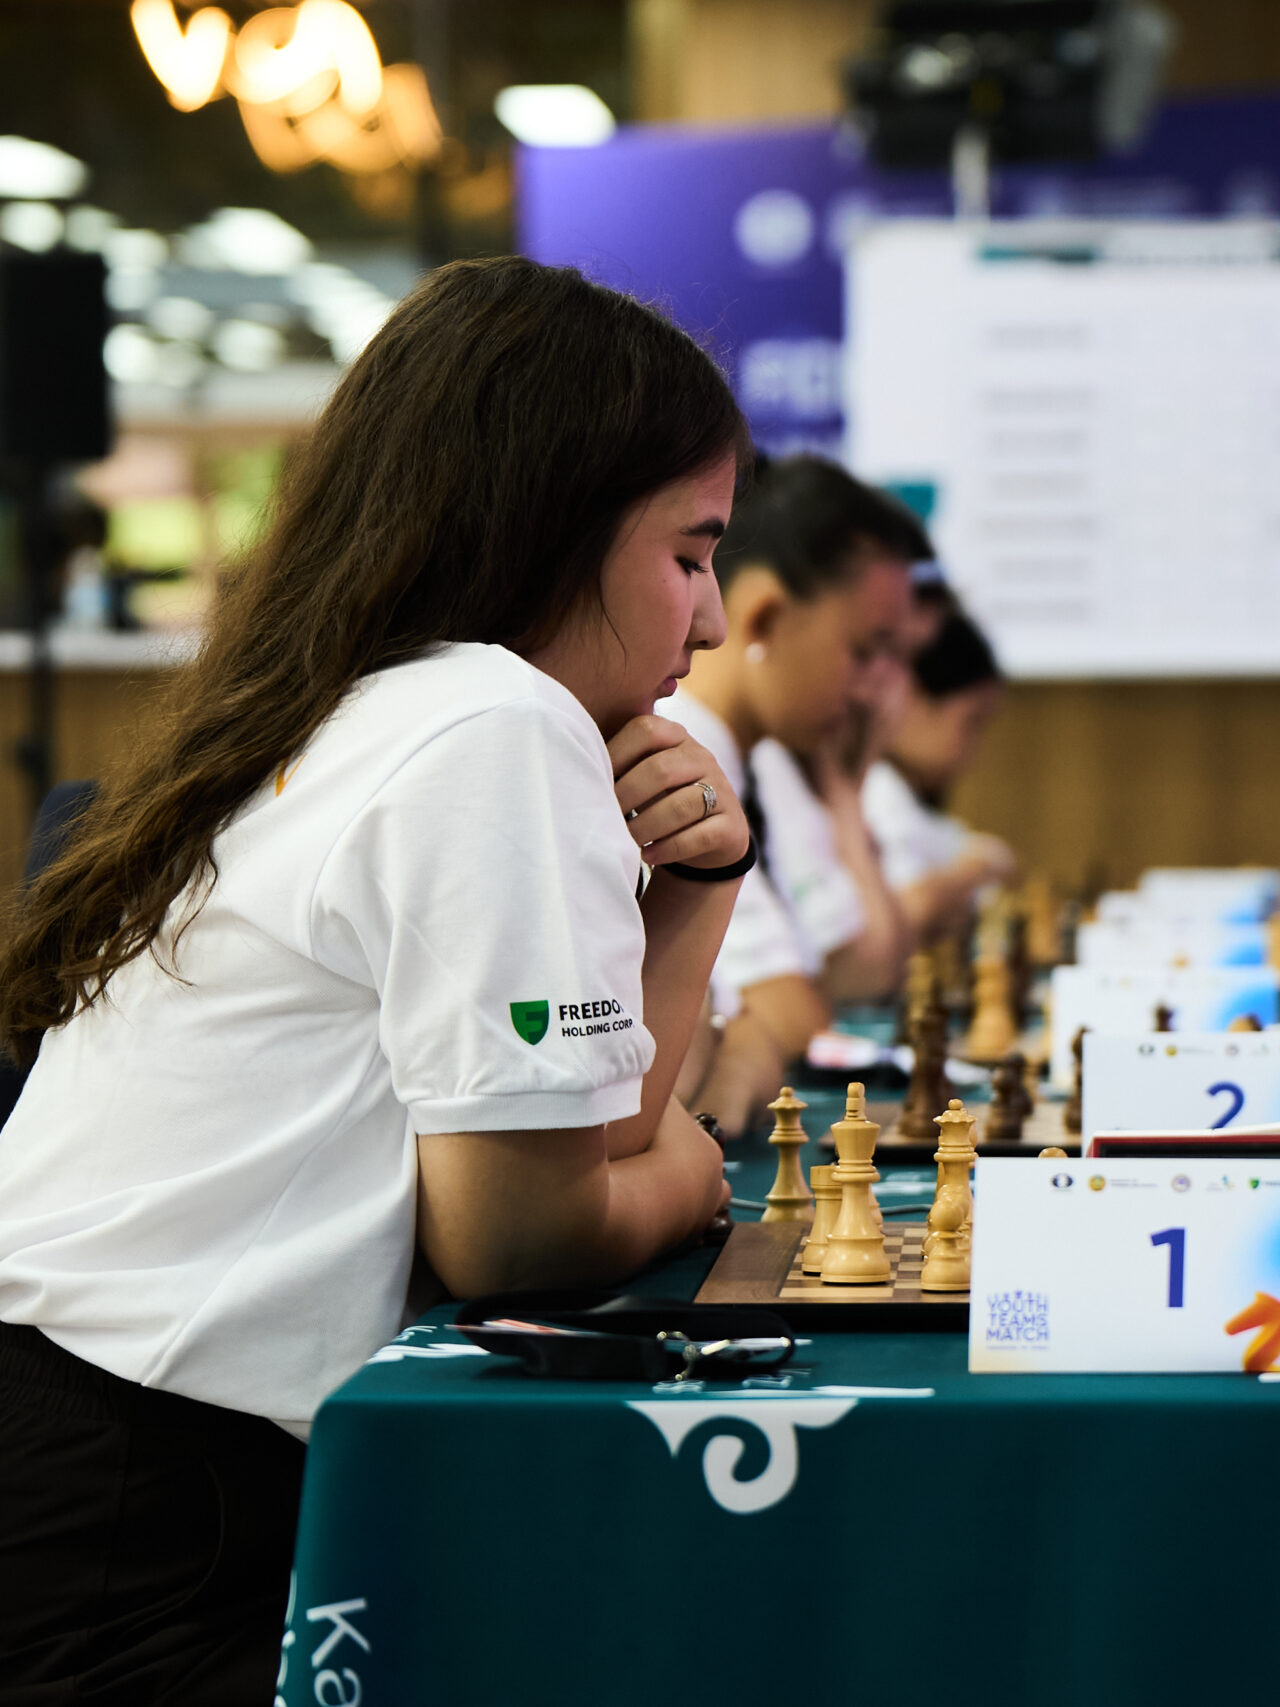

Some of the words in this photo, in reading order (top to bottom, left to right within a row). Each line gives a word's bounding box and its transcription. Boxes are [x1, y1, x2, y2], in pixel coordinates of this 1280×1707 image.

[559, 999, 623, 1021] FREEDO
[562, 1022, 610, 1037] HOLDING
[1206, 1082, 1245, 1130] 2
[1150, 1227, 1186, 1308] 1
[986, 1293, 1048, 1312] YOUTH
[988, 1312, 1048, 1327] TEAMS
[986, 1327, 1049, 1341] MATCH
